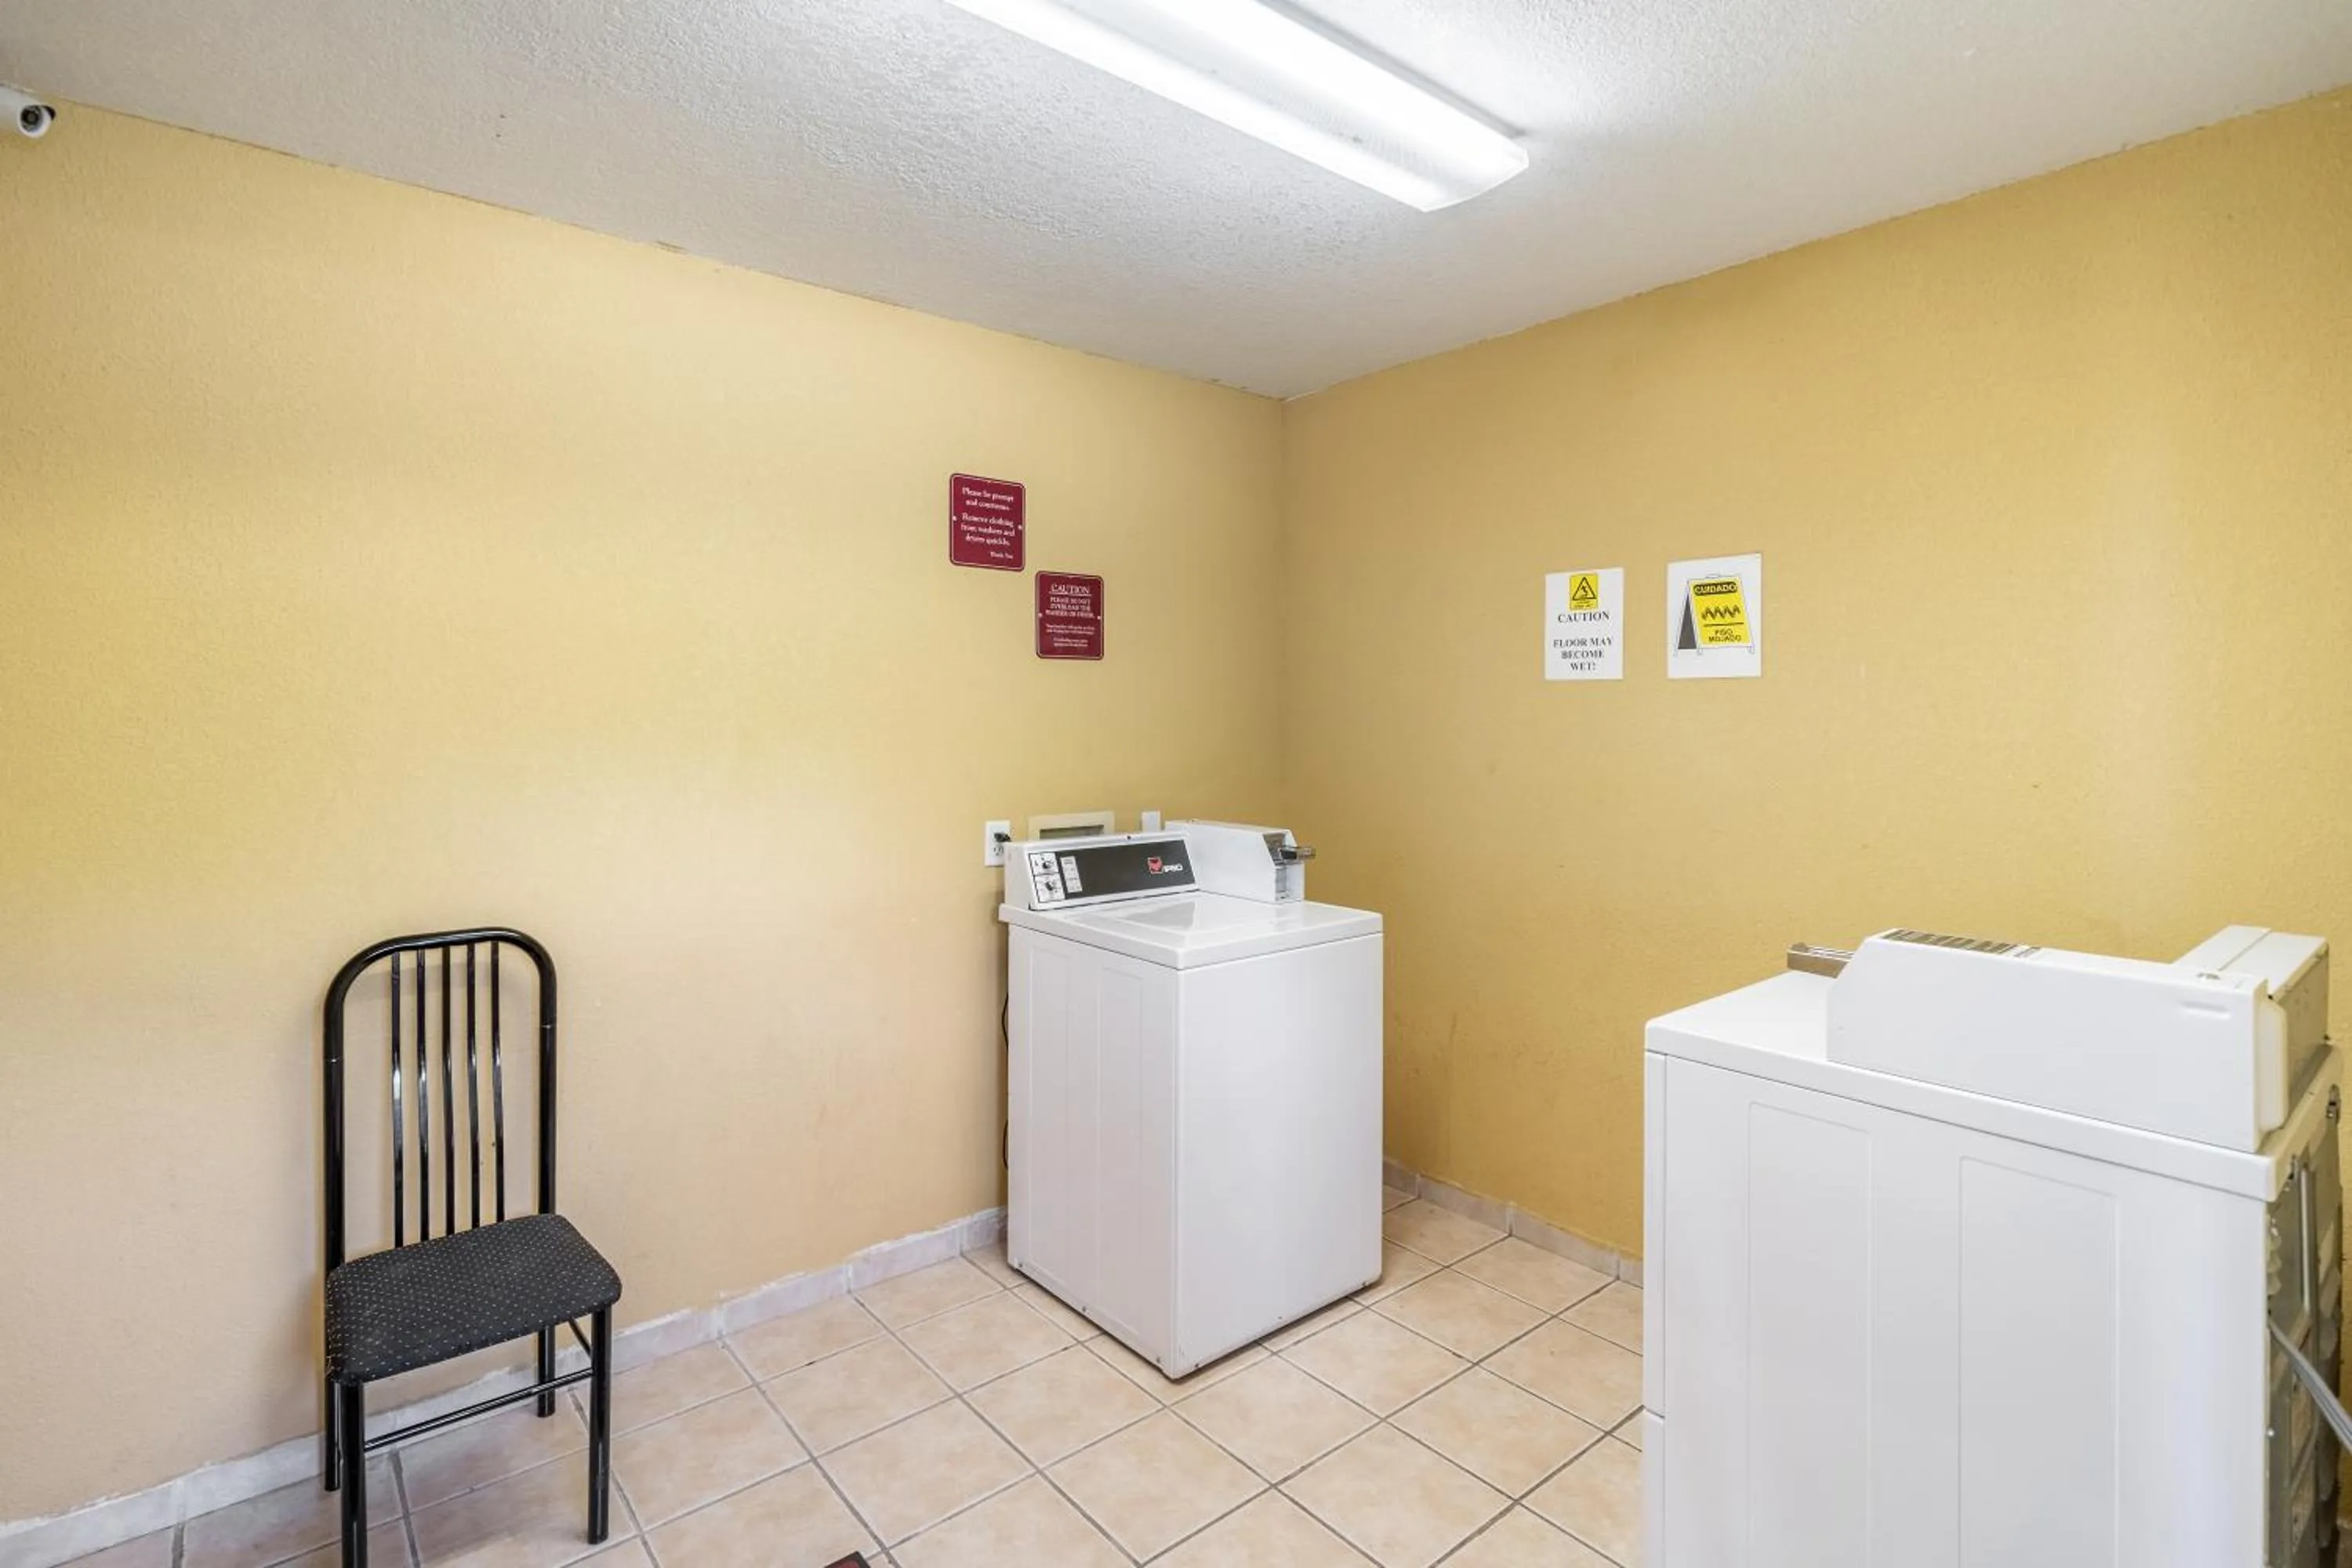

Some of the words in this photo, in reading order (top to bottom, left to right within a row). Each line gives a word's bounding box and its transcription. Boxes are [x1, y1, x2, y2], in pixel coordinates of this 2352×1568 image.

[962, 487, 982, 497] Please
[962, 512, 989, 523] Remove
[1051, 583, 1091, 594] CAUTION
[1694, 583, 1737, 593] CUIDADO
[1557, 611, 1610, 623] CAUTION
[1553, 637, 1588, 648] FLOOR
[1589, 636, 1612, 646] MAY
[1561, 649, 1605, 659] BECOME
[1570, 662, 1596, 671] WET!
